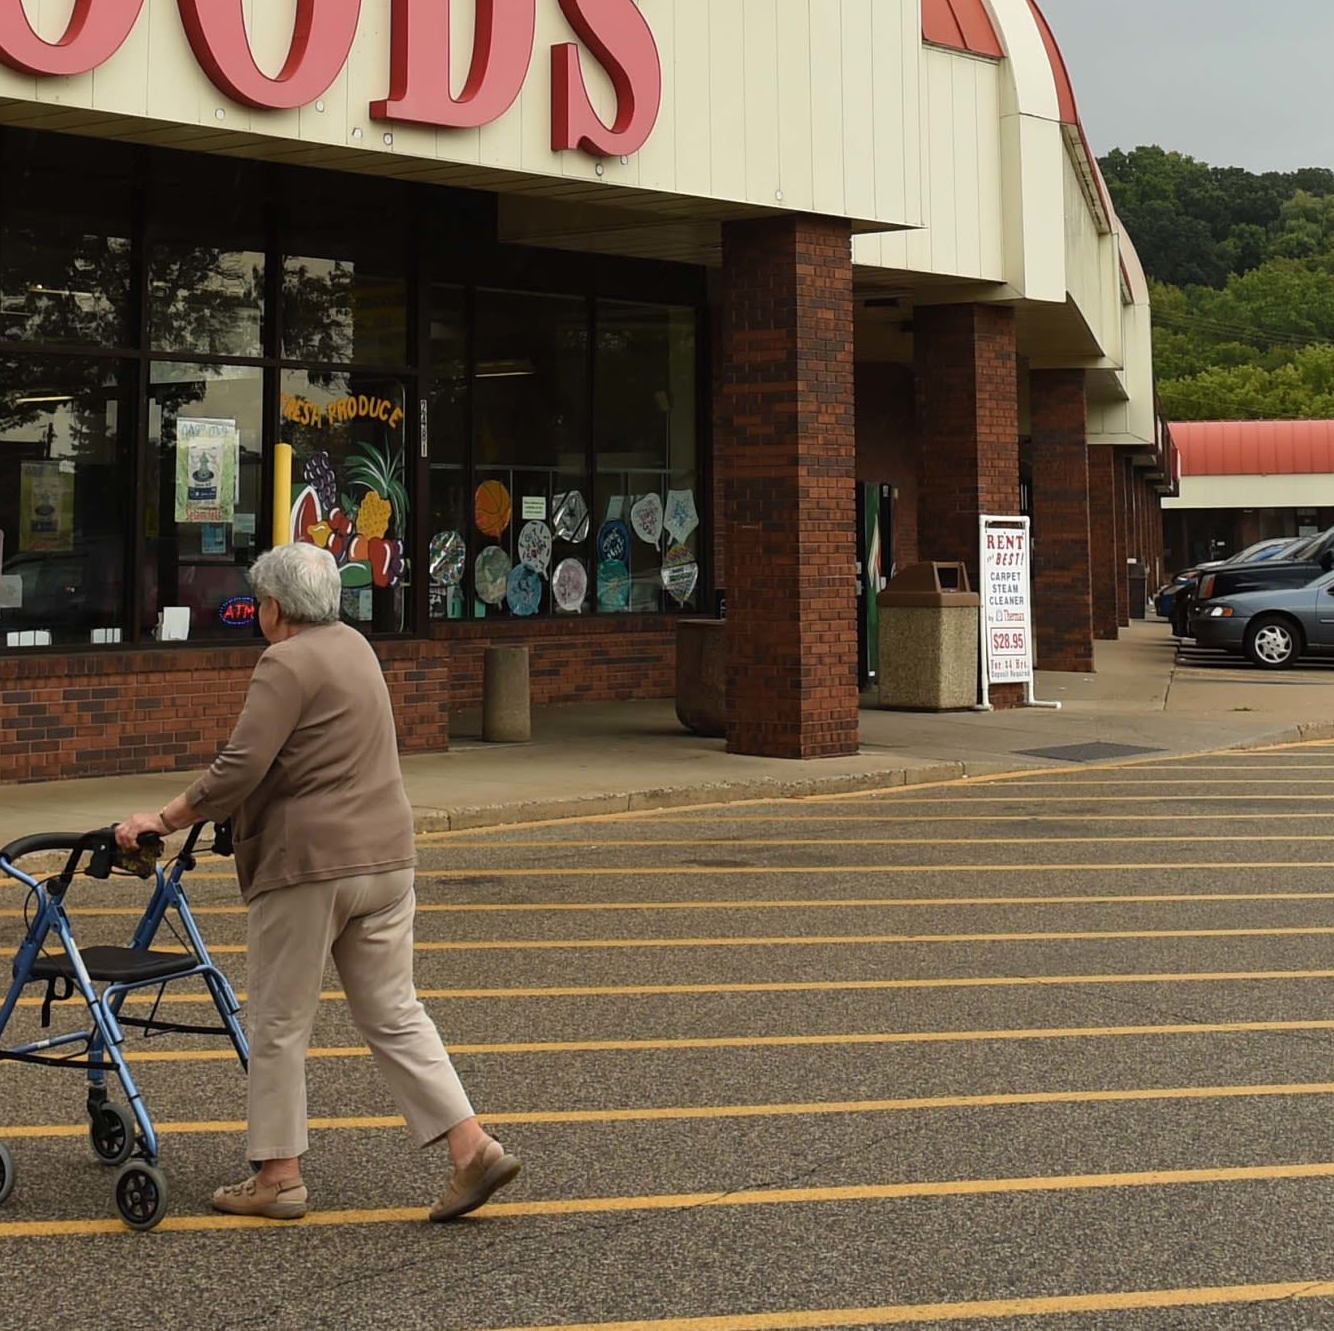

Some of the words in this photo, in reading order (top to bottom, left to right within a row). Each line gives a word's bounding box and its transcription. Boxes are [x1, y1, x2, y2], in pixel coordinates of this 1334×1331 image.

[327, 394, 404, 429] PRODUCE
[987, 534, 1024, 549] RENT
[996, 552, 1024, 566] BEST!
[990, 572, 1021, 581] CARPET
[992, 584, 1019, 593] STEAM
[989, 596, 1024, 605] CLEANER
[224, 604, 255, 619] ATM
[993, 633, 1023, 650] $28.95
